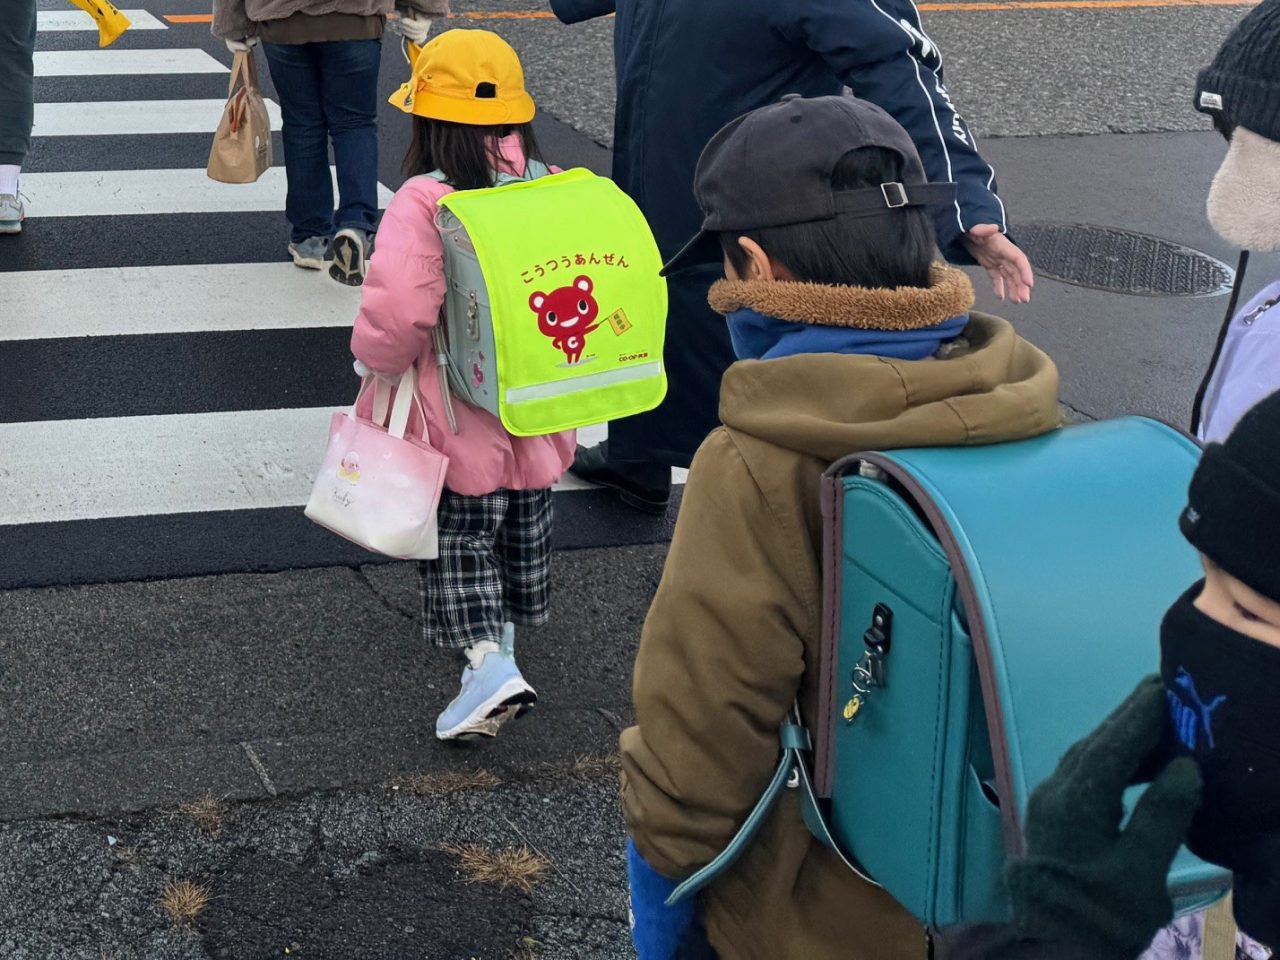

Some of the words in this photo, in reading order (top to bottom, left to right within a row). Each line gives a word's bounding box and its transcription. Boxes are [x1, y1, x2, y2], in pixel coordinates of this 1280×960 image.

[520, 252, 629, 284] こうつうあんぜん
